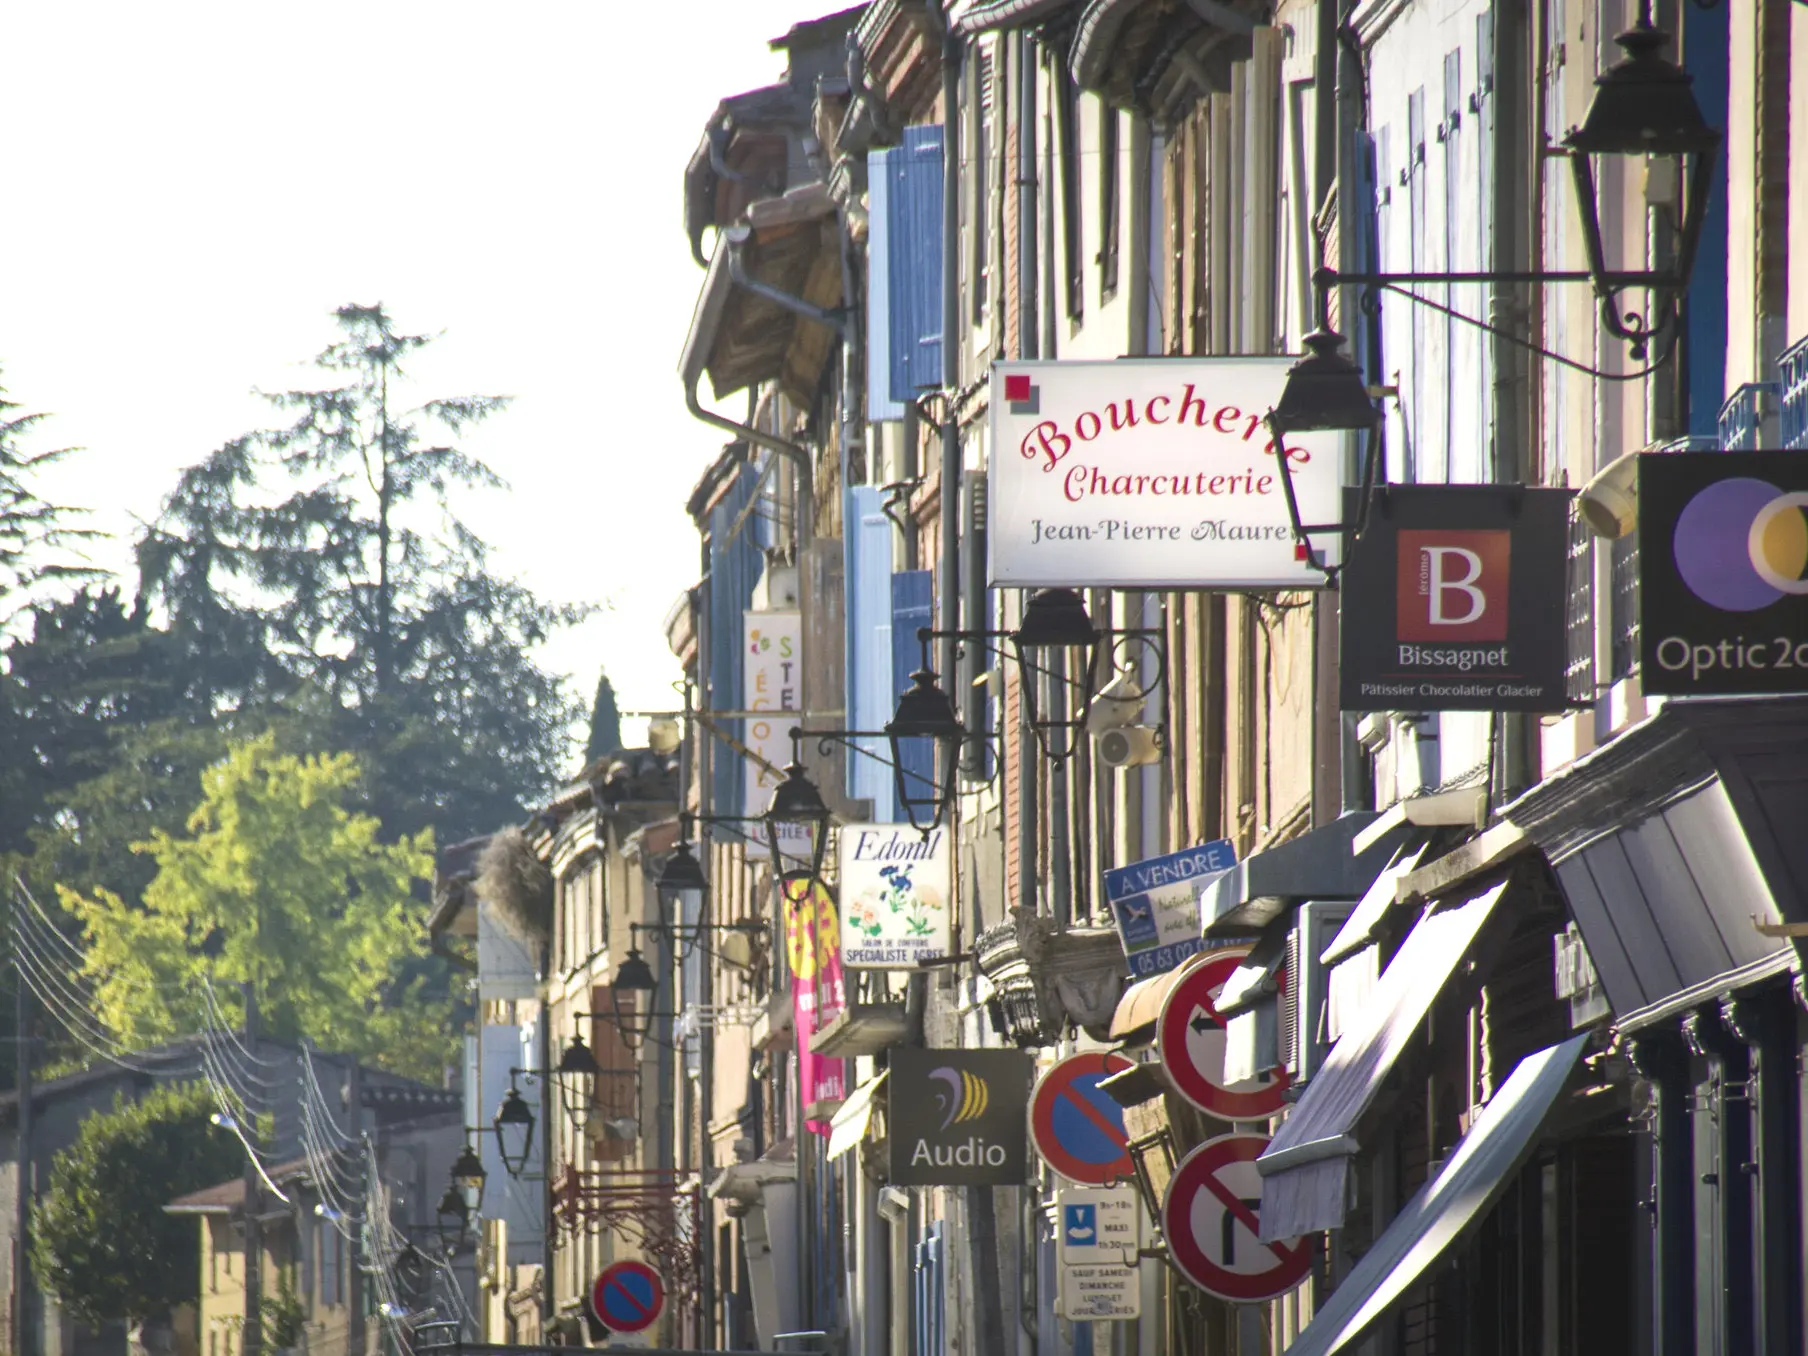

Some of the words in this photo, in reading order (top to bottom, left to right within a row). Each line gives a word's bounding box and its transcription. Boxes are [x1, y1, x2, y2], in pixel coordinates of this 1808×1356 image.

[1063, 464, 1273, 502] Charcuterie
[1031, 519, 1181, 545] Jean-Pierre
[1420, 546, 1486, 625] B
[1398, 645, 1509, 671] Bissagnet
[1656, 635, 1766, 681] Optic
[1361, 682, 1416, 697] Pâtissier
[1419, 683, 1494, 697] Chocolatier
[1497, 684, 1543, 697] Glacier
[1121, 875, 1136, 895] A
[1136, 850, 1223, 887] VENDRE
[911, 1137, 1006, 1167] Audio
[1104, 1224, 1129, 1232] MAXI
